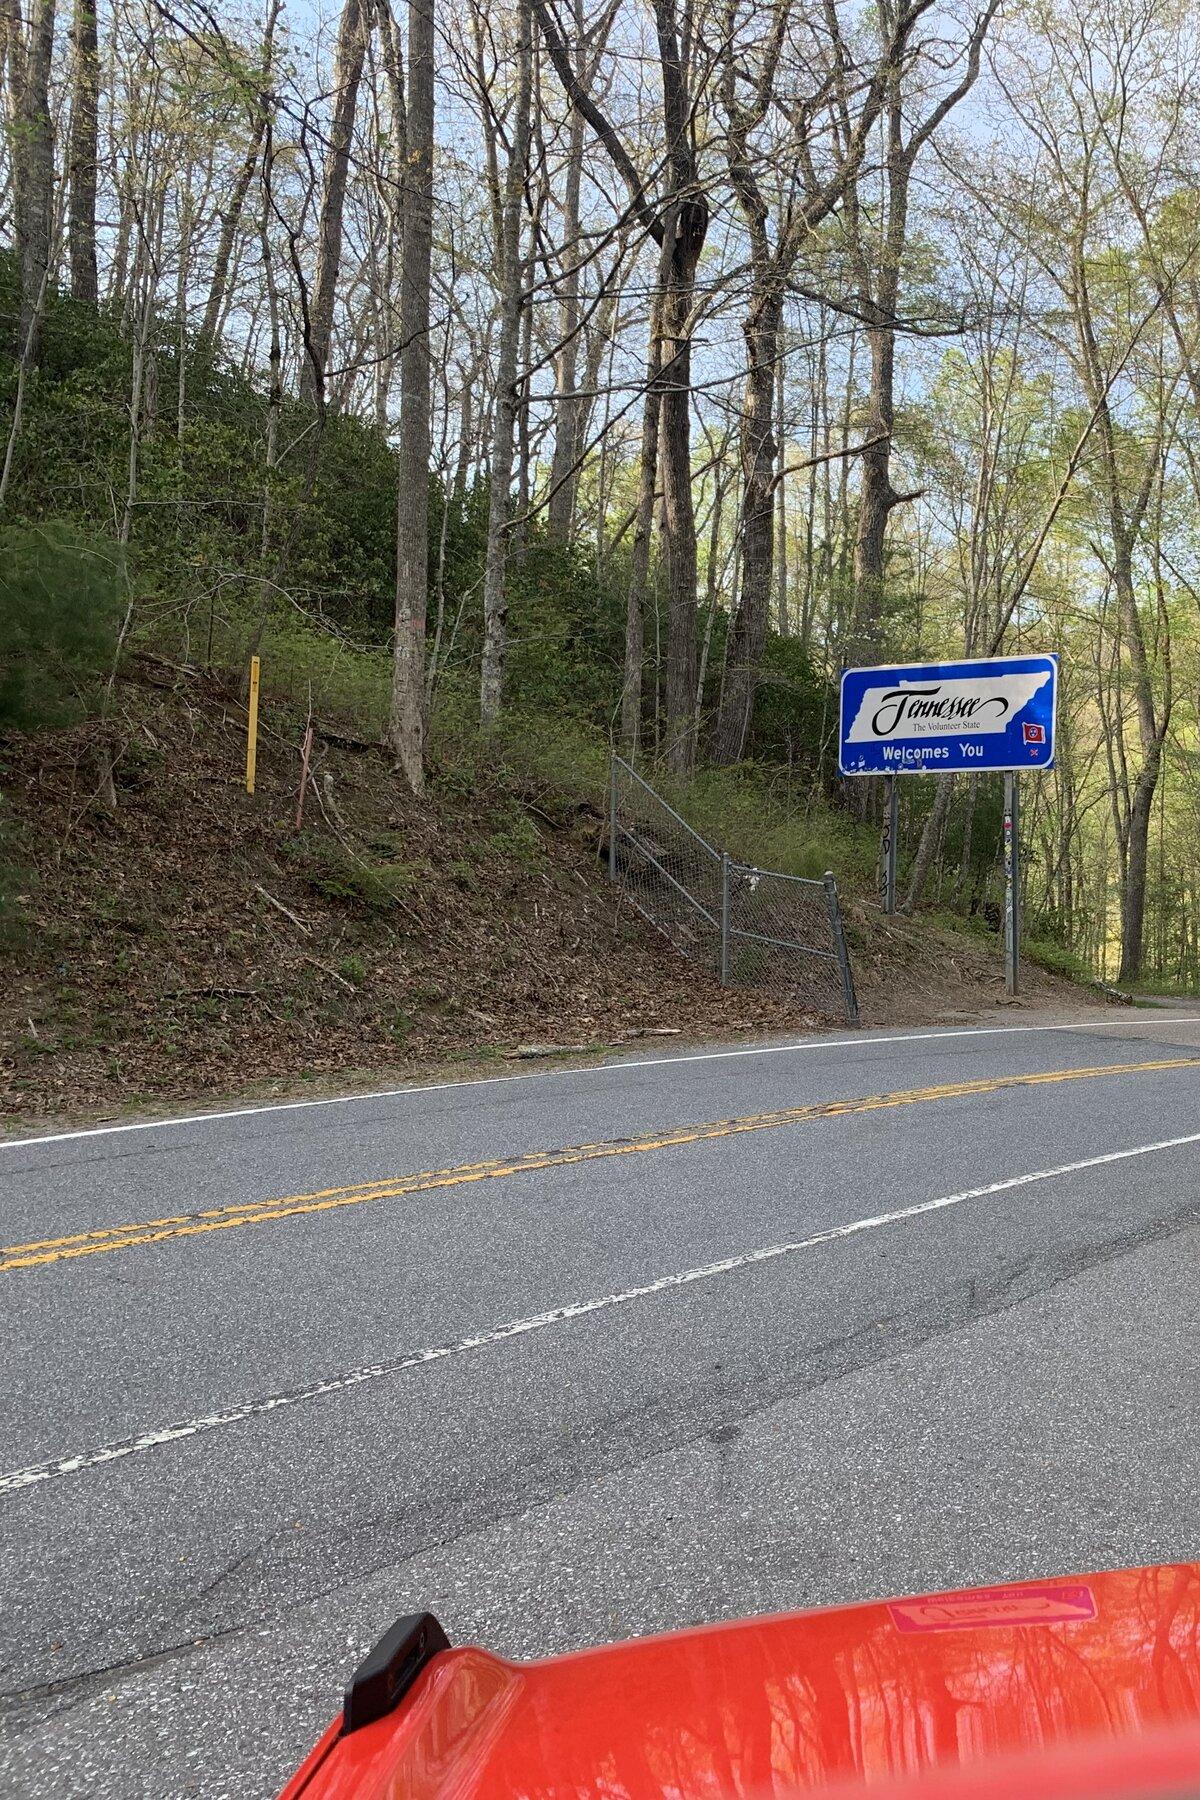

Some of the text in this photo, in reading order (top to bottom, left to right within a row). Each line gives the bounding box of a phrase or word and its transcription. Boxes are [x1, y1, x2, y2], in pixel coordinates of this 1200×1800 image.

[872, 686, 1009, 736] Tennessee
[913, 720, 981, 732] The Volunteer State
[883, 743, 984, 760] Welcomes You
